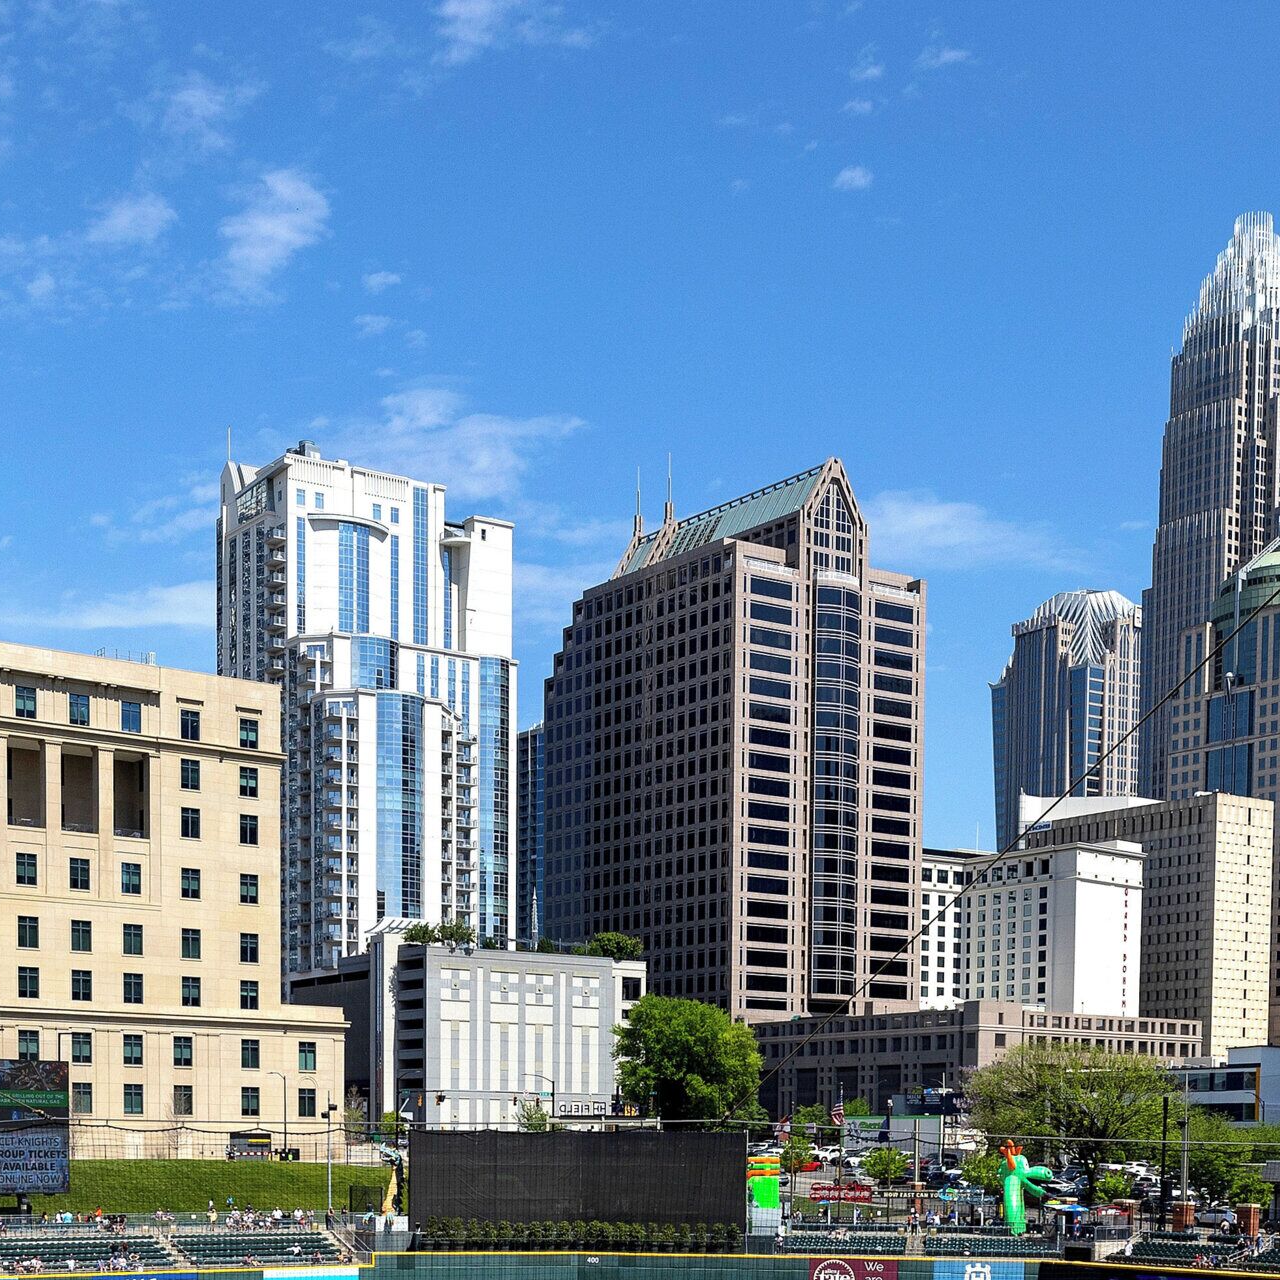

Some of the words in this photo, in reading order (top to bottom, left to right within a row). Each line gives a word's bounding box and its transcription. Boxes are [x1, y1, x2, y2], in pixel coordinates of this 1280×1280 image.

[18, 1137, 60, 1146] KNIGHTS
[28, 1149, 68, 1159] TICKETS
[2, 1162, 56, 1171] AVAILABLE
[36, 1174, 60, 1184] NOW
[586, 1256, 600, 1264] 400
[864, 1261, 884, 1272] We
